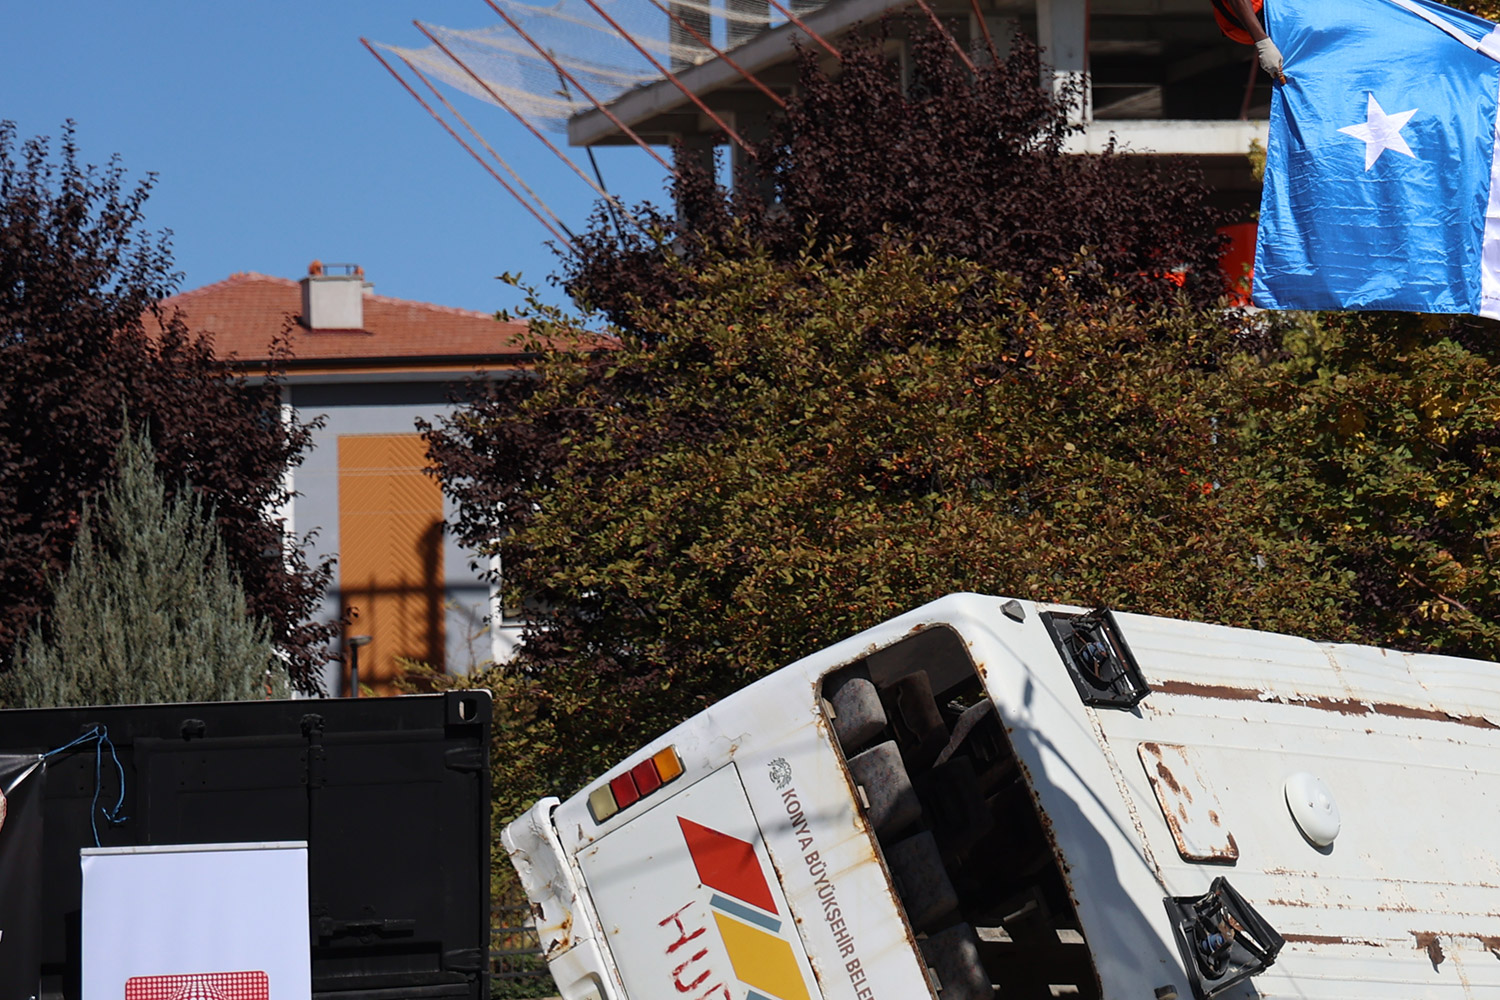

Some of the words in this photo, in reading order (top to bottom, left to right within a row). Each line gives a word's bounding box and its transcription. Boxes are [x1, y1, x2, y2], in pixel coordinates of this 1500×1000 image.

[781, 788, 814, 851] KONYA
[804, 851, 855, 959] BÜYÜKŞEHİR
[845, 957, 876, 1000] BELE
